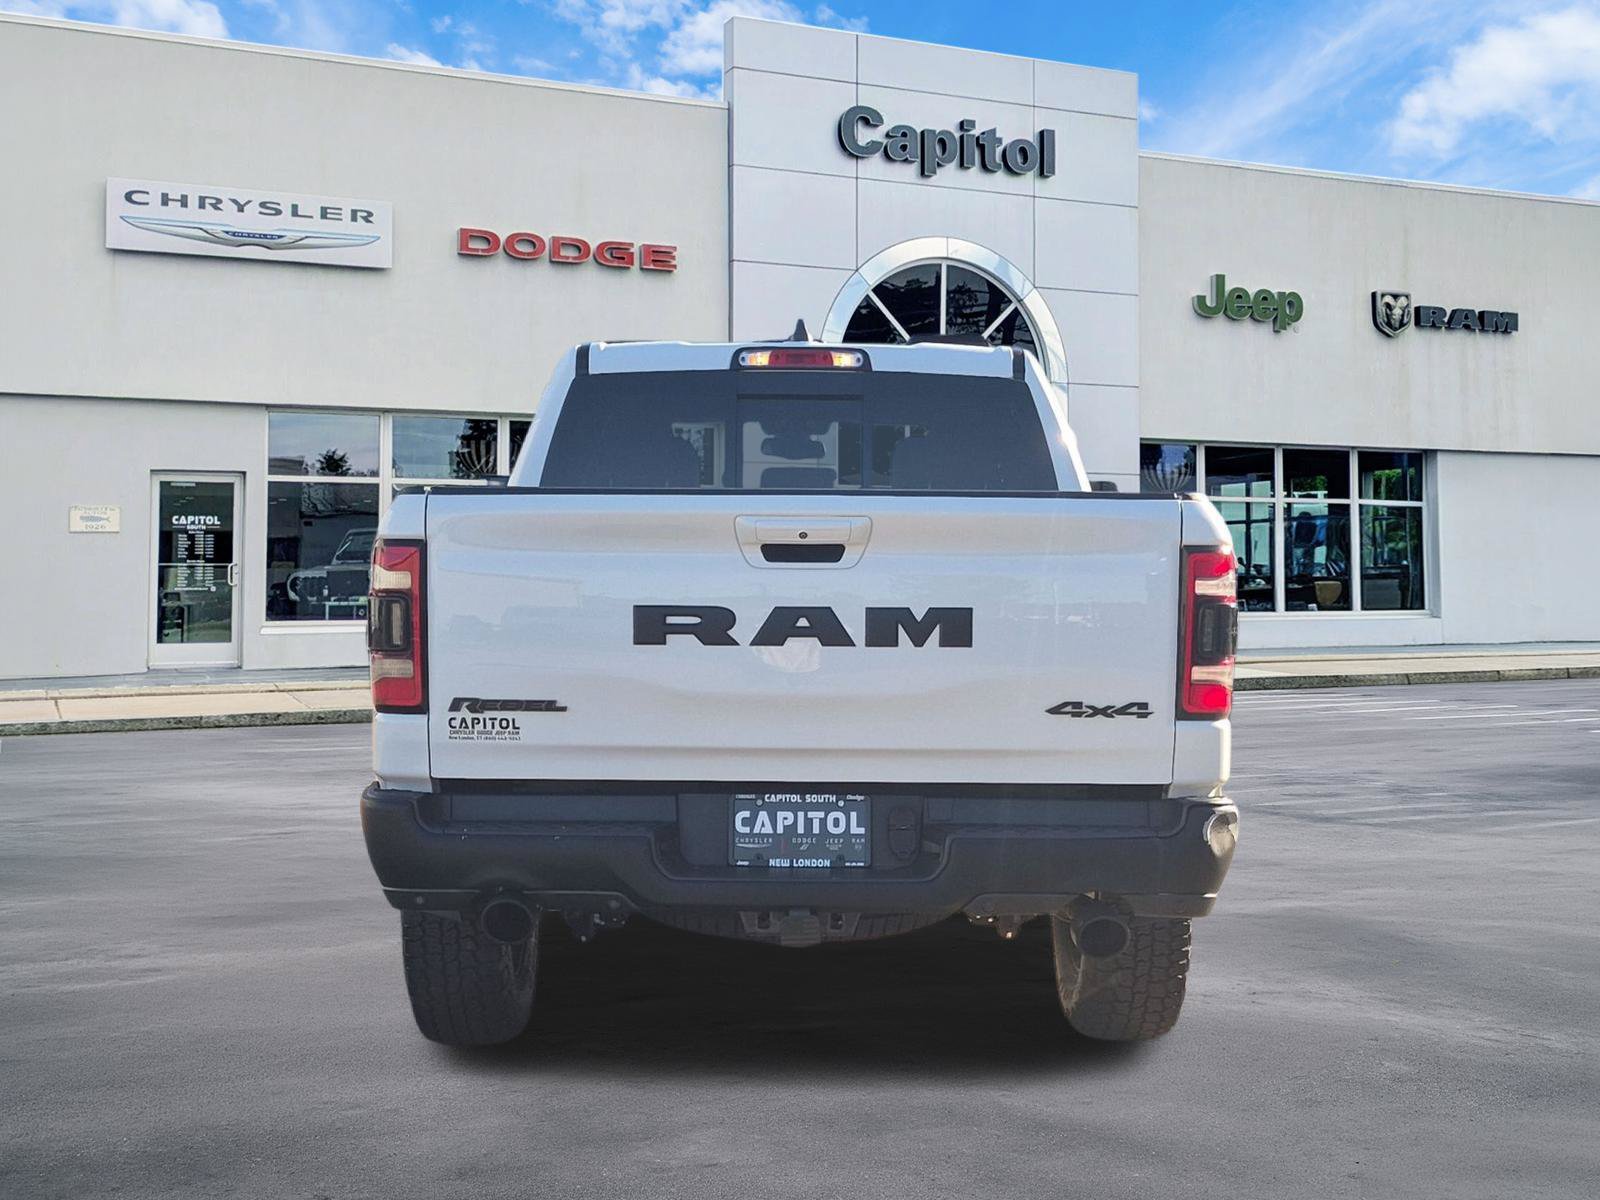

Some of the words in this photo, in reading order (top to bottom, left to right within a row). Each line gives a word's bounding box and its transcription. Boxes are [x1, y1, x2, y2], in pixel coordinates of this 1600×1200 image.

[838, 105, 1056, 178] Capitol
[124, 189, 375, 224] CHRYSLER
[457, 227, 678, 272] DODGE
[1192, 273, 1304, 333] Jeep
[1414, 305, 1519, 333] RAM
[172, 515, 221, 525] CAPITOL
[633, 605, 974, 648] RAM
[1044, 701, 1155, 719] 4x4
[448, 717, 521, 730] CAPITOL
[764, 794, 803, 803] CAPITOL
[805, 794, 837, 803] SOUTH
[735, 811, 866, 834] CAPITOL
[769, 858, 790, 867] NEW
[793, 858, 831, 867] LONDON
